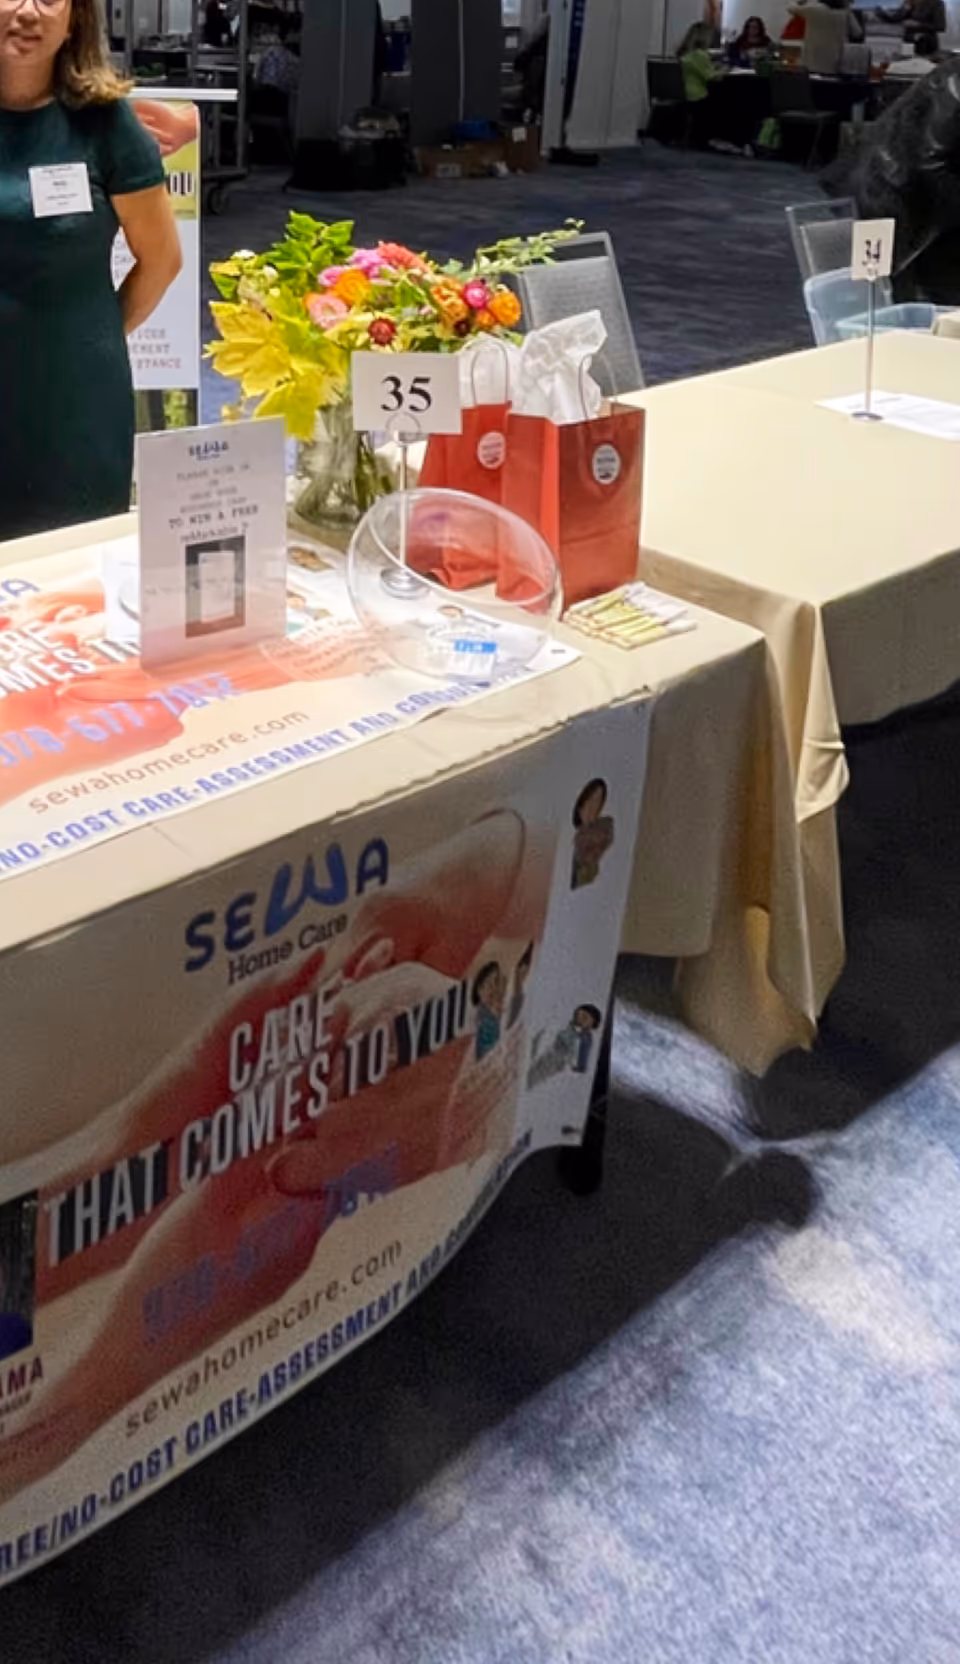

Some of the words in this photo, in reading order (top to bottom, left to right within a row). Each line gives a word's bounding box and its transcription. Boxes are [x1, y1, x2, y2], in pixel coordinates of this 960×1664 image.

[380, 375, 432, 414] 35
[28, 710, 311, 814] sewahomecare.com
[350, 711, 400, 737] AND
[184, 836, 389, 973] SEWA
[228, 938, 294, 985] Home
[298, 913, 348, 951] Care
[228, 983, 340, 1094] CARE
[43, 1142, 165, 1267] THAT
[179, 1052, 331, 1194] COMES
[344, 1022, 388, 1096] TO
[405, 980, 472, 1066] YOU
[126, 1239, 403, 1436] sewahomecare.com
